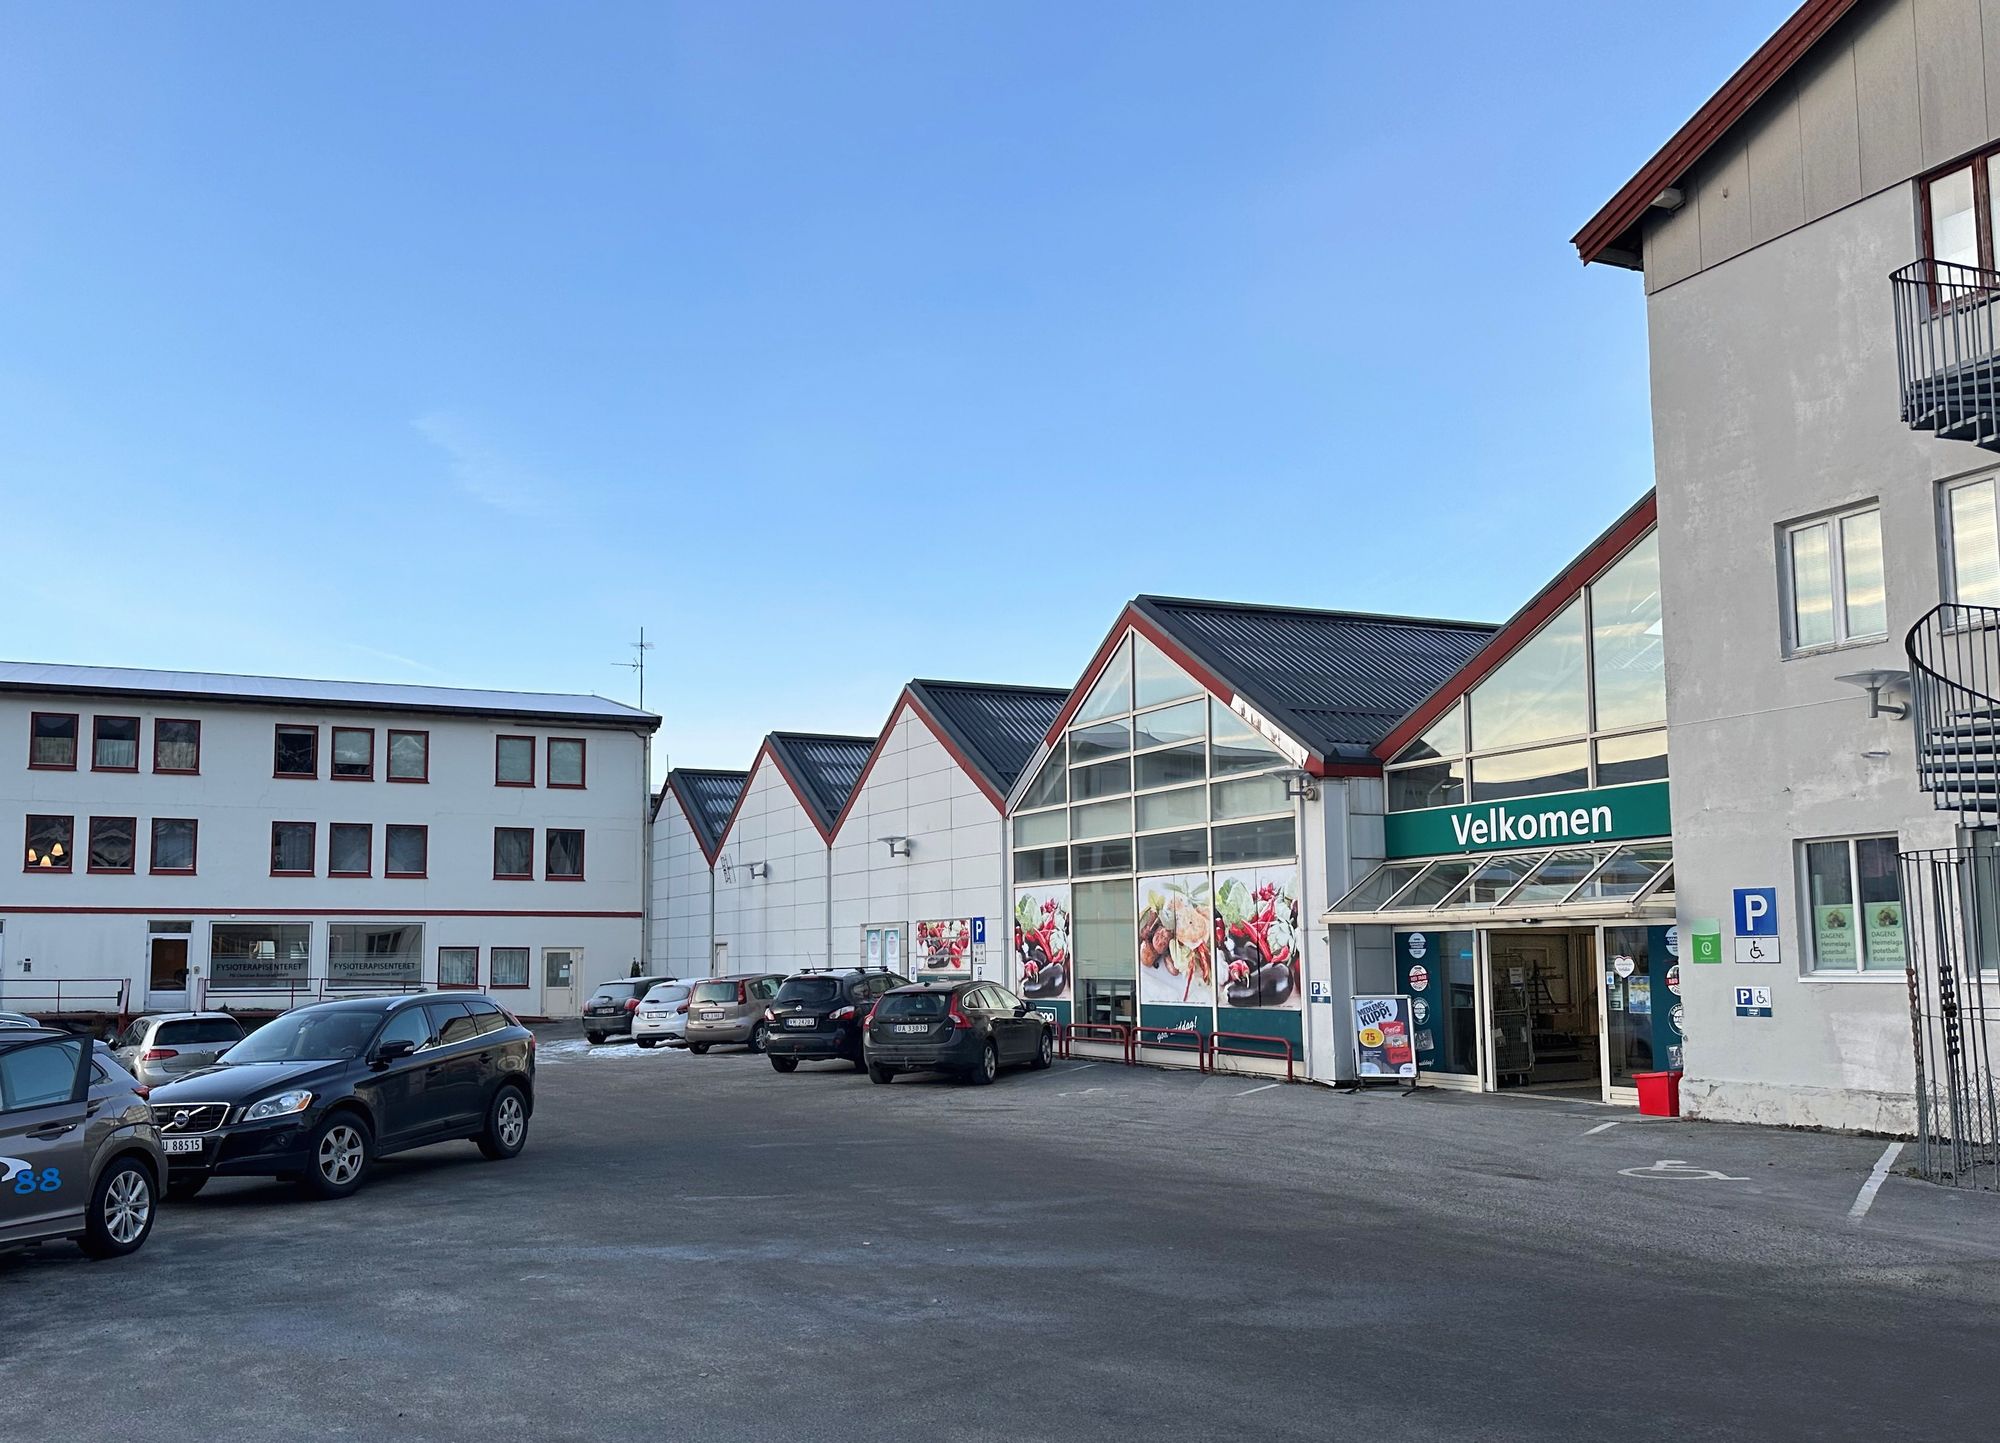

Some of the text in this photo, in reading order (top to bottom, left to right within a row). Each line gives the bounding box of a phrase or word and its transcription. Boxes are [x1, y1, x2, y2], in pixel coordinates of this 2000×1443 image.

[1451, 805, 1613, 846] Velkomen
[1745, 894, 1768, 931] P
[975, 920, 983, 940] P
[216, 963, 302, 971] FYSIOTERAPISENTERET
[1313, 983, 1319, 994] P
[1740, 990, 1750, 1004] P
[1360, 1006, 1392, 1026] KUPP!
[1365, 1032, 1376, 1041] 75
[173, 1140, 200, 1151] 88515
